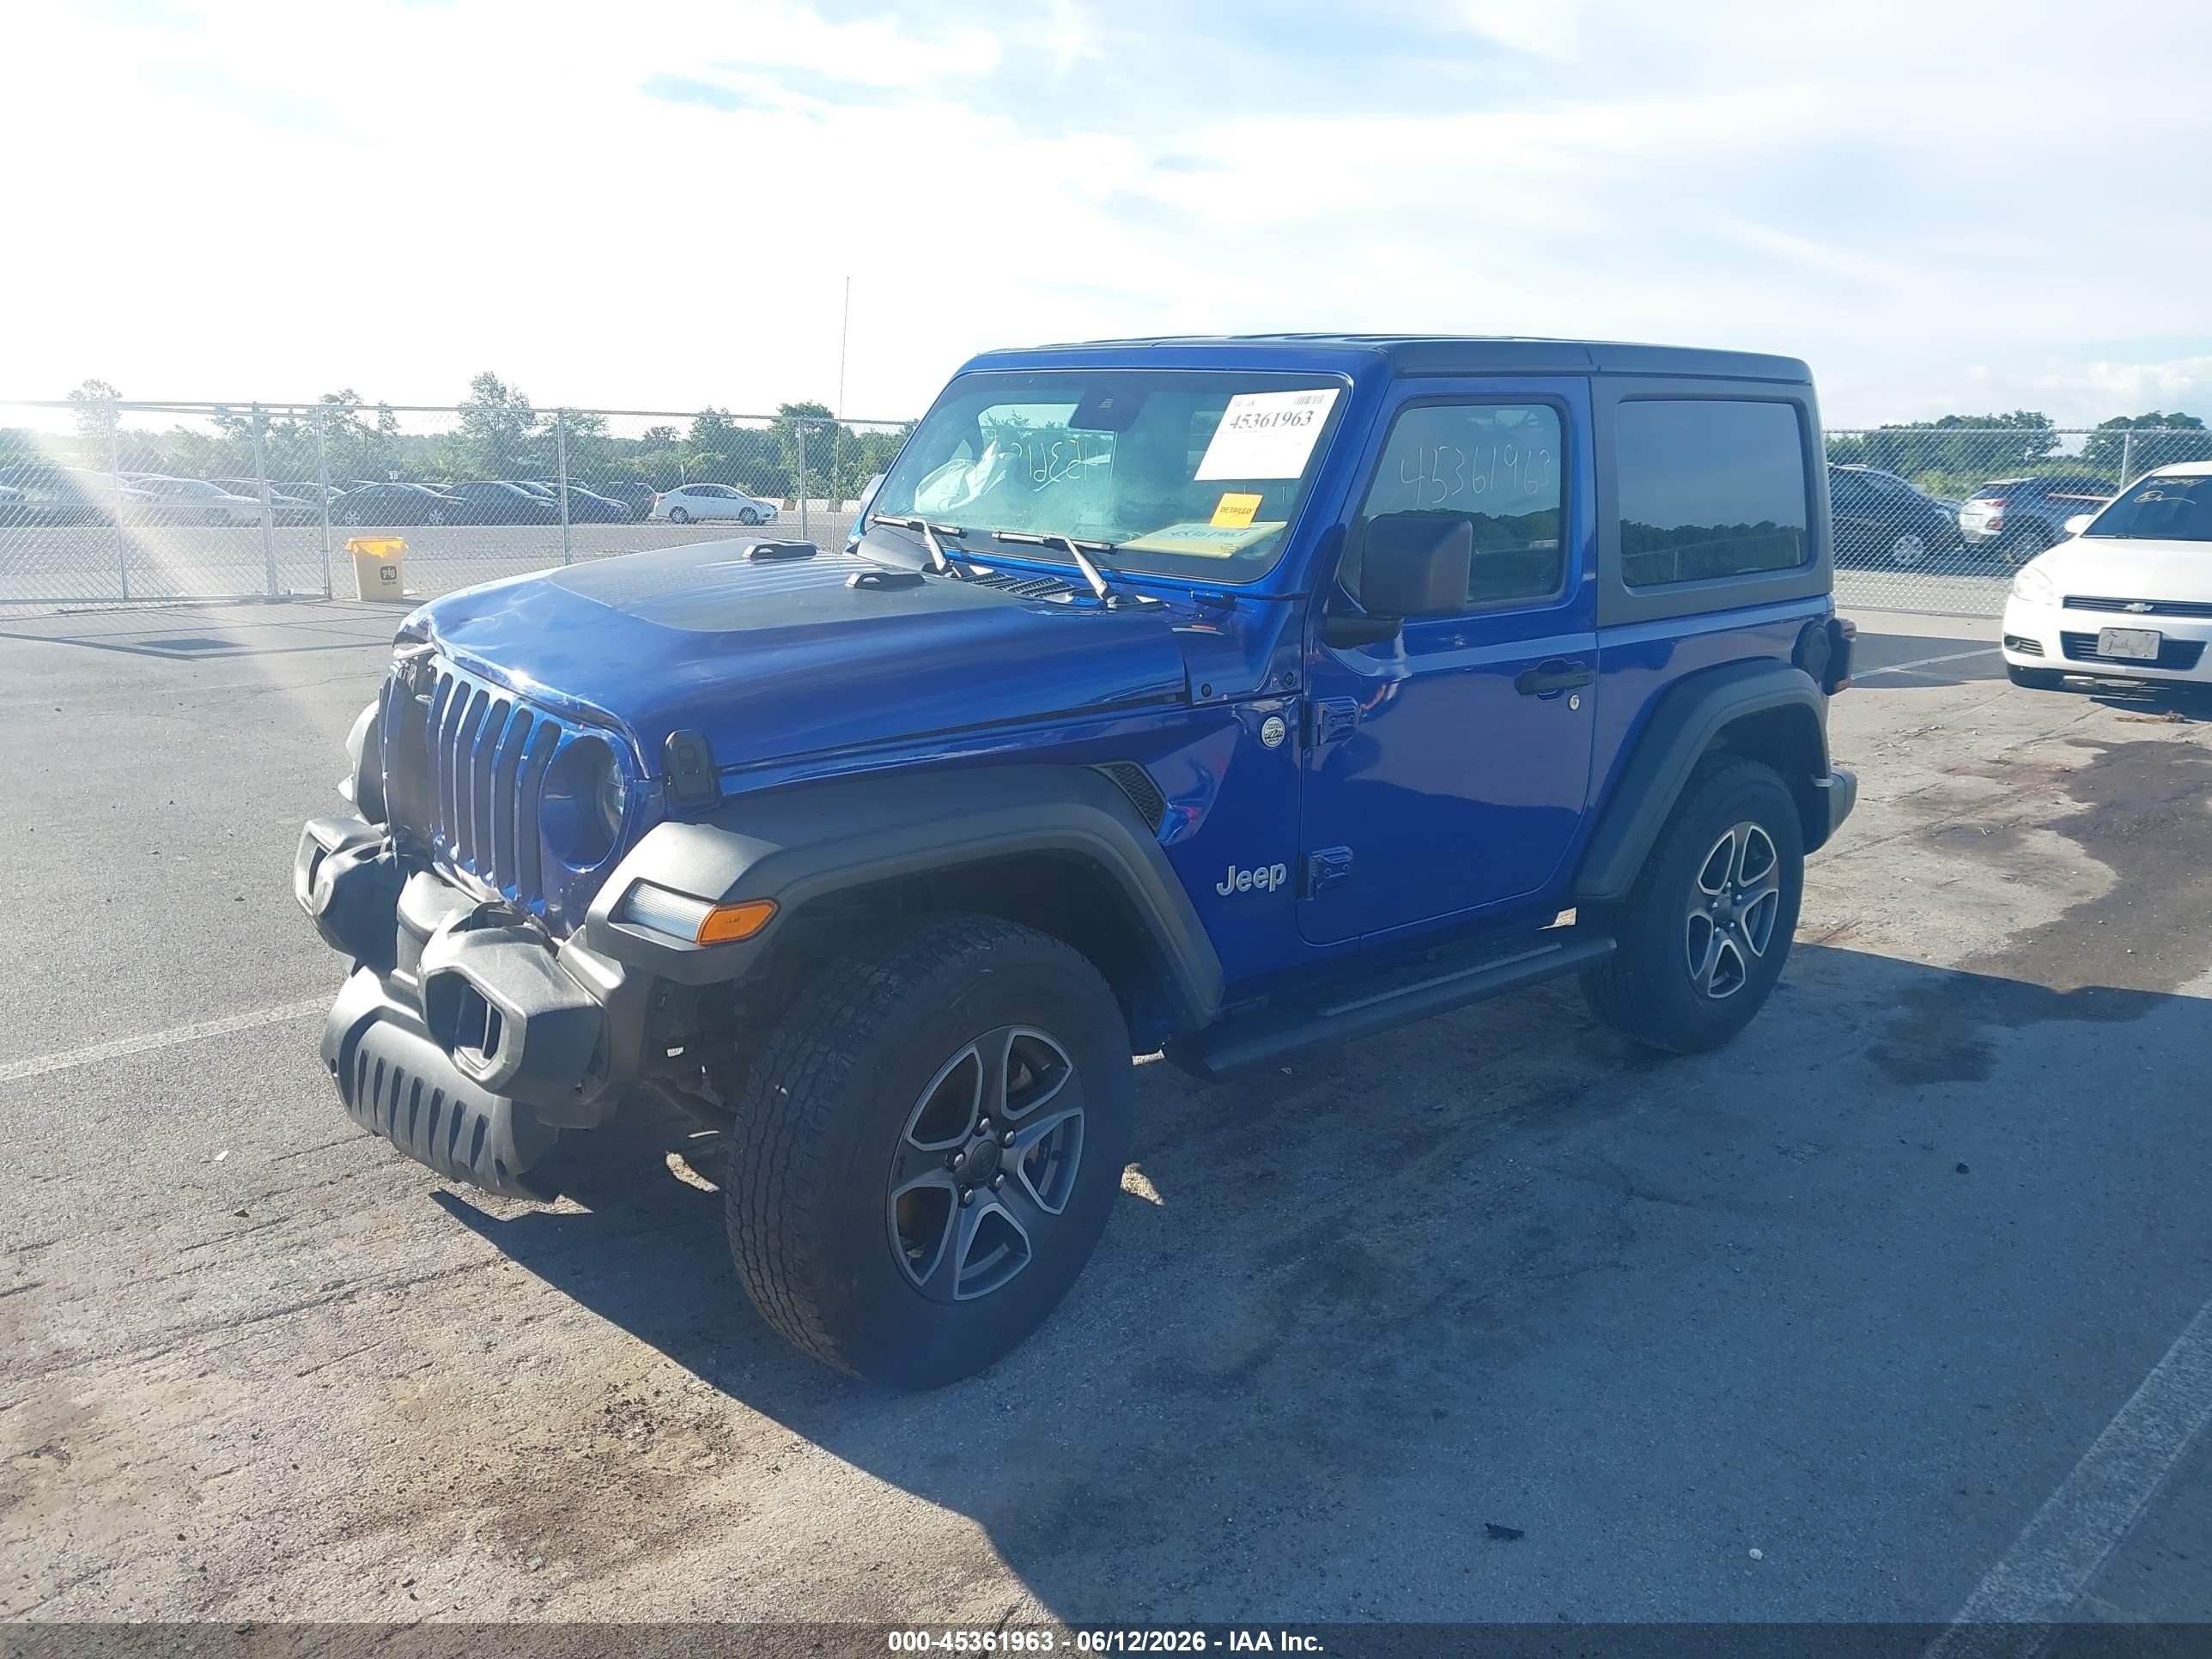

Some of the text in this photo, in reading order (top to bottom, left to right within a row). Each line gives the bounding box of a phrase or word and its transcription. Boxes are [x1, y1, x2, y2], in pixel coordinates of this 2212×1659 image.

[1229, 410, 1315, 429] 45361963
[1401, 443, 1551, 506] 45361963
[1216, 862, 1287, 896] Jeep
